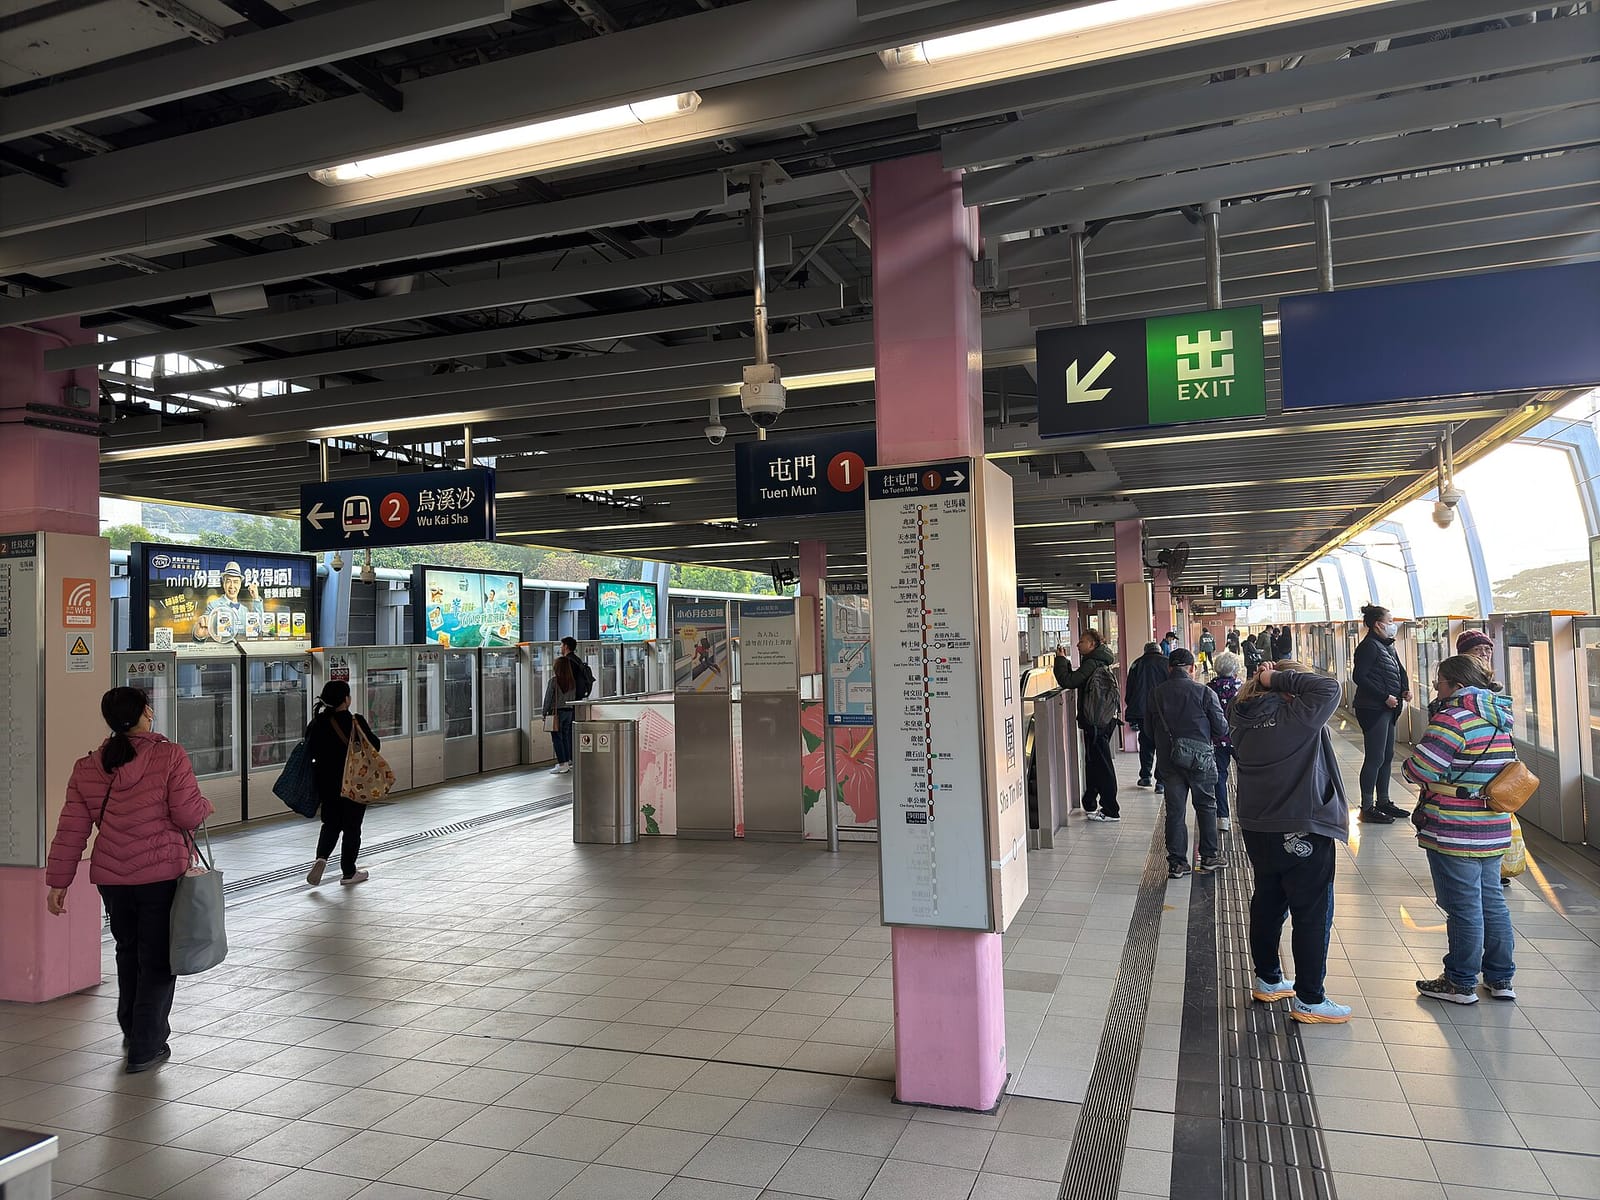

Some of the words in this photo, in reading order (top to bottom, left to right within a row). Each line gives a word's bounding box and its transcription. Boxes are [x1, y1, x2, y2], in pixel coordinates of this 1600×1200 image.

[1176, 329, 1235, 381] 出
[1178, 379, 1235, 401] EXIT
[768, 454, 817, 481] 屯門
[839, 459, 850, 485] 1
[883, 472, 918, 487] 往屯門
[928, 474, 935, 487] 1
[417, 486, 476, 512] 烏溪沙
[760, 486, 788, 499] Tuen
[791, 485, 817, 497] Mun
[388, 498, 401, 522] 2
[417, 515, 433, 526] Wu
[434, 514, 449, 526] Kai
[451, 513, 469, 525] Sha
[1, 543, 7, 553] 2
[1000, 789, 1009, 815] Sha
